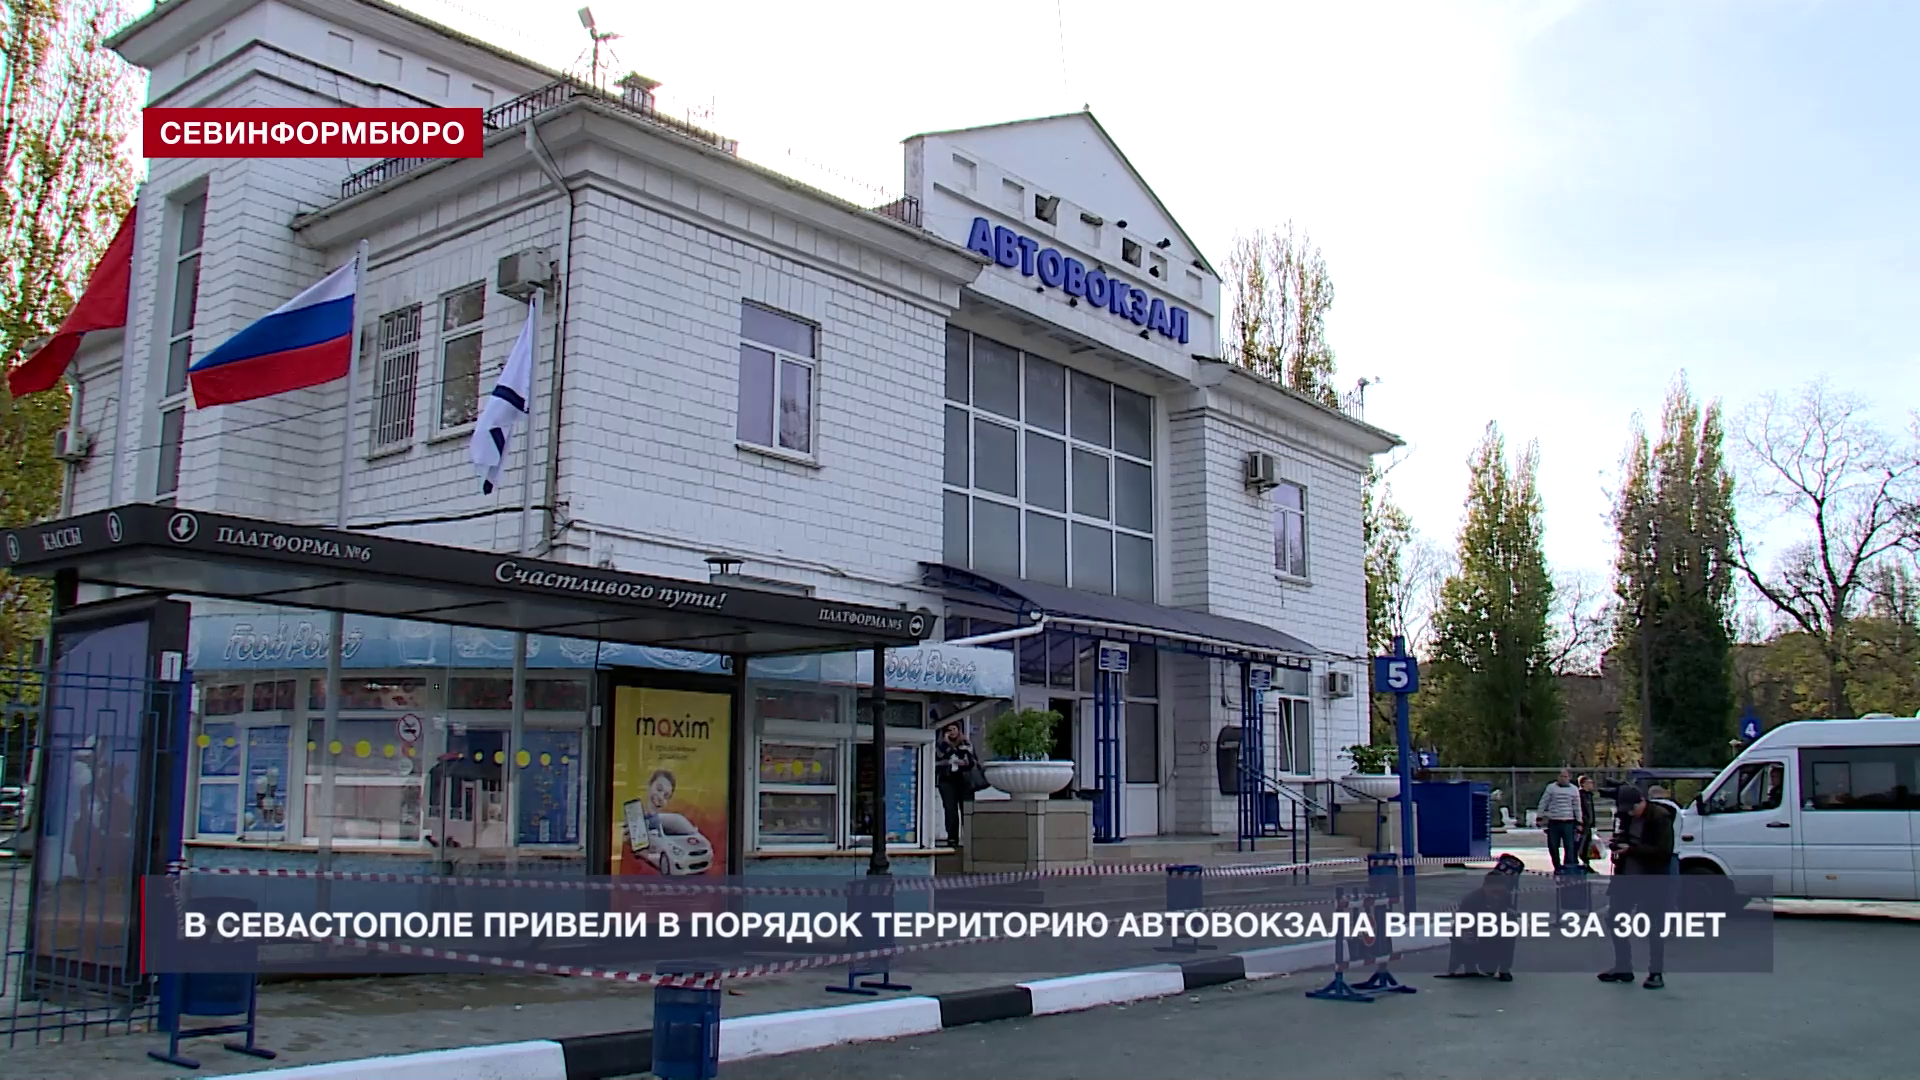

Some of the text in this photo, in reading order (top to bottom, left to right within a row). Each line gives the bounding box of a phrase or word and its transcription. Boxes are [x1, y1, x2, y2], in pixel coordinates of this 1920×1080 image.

[967, 216, 1189, 344] АВТОВОКЗАЛ
[42, 526, 82, 551] КАССЫ
[216, 526, 371, 562] ПЛАТФОРМА №6
[495, 561, 728, 609] Счастливого пути!
[818, 608, 886, 629] ПЛАТФОРМА
[223, 622, 288, 661] Food
[884, 648, 925, 682] ood
[1387, 661, 1409, 689] 5
[635, 713, 709, 740] maxim
[1744, 721, 1757, 738] 4
